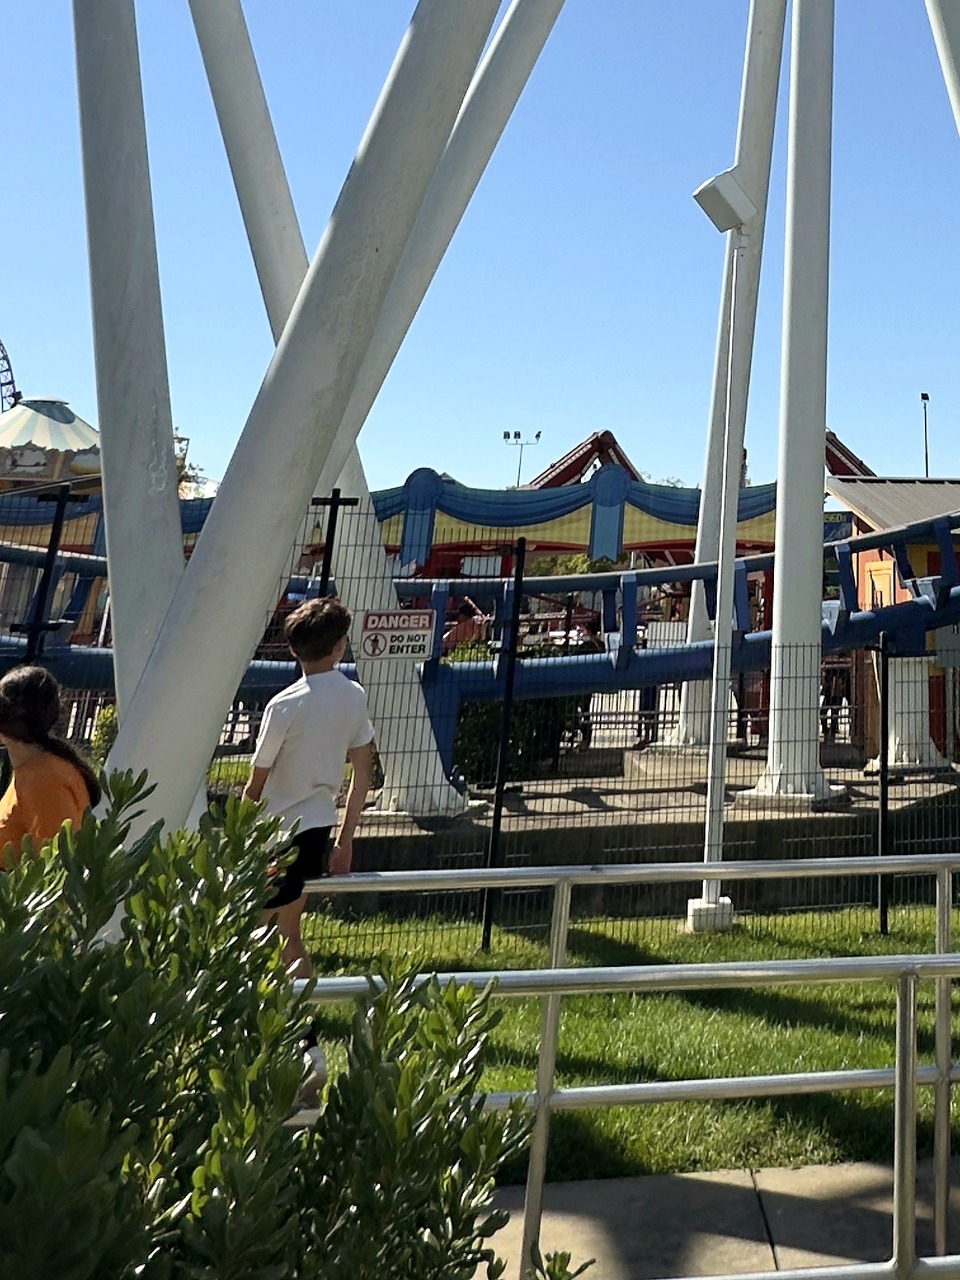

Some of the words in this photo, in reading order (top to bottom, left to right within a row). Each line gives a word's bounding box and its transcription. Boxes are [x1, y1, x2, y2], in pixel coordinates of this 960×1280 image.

[367, 615, 430, 629] DANGER
[390, 634, 405, 643] DO
[406, 634, 427, 643] NOT
[388, 644, 426, 654] ENTER
